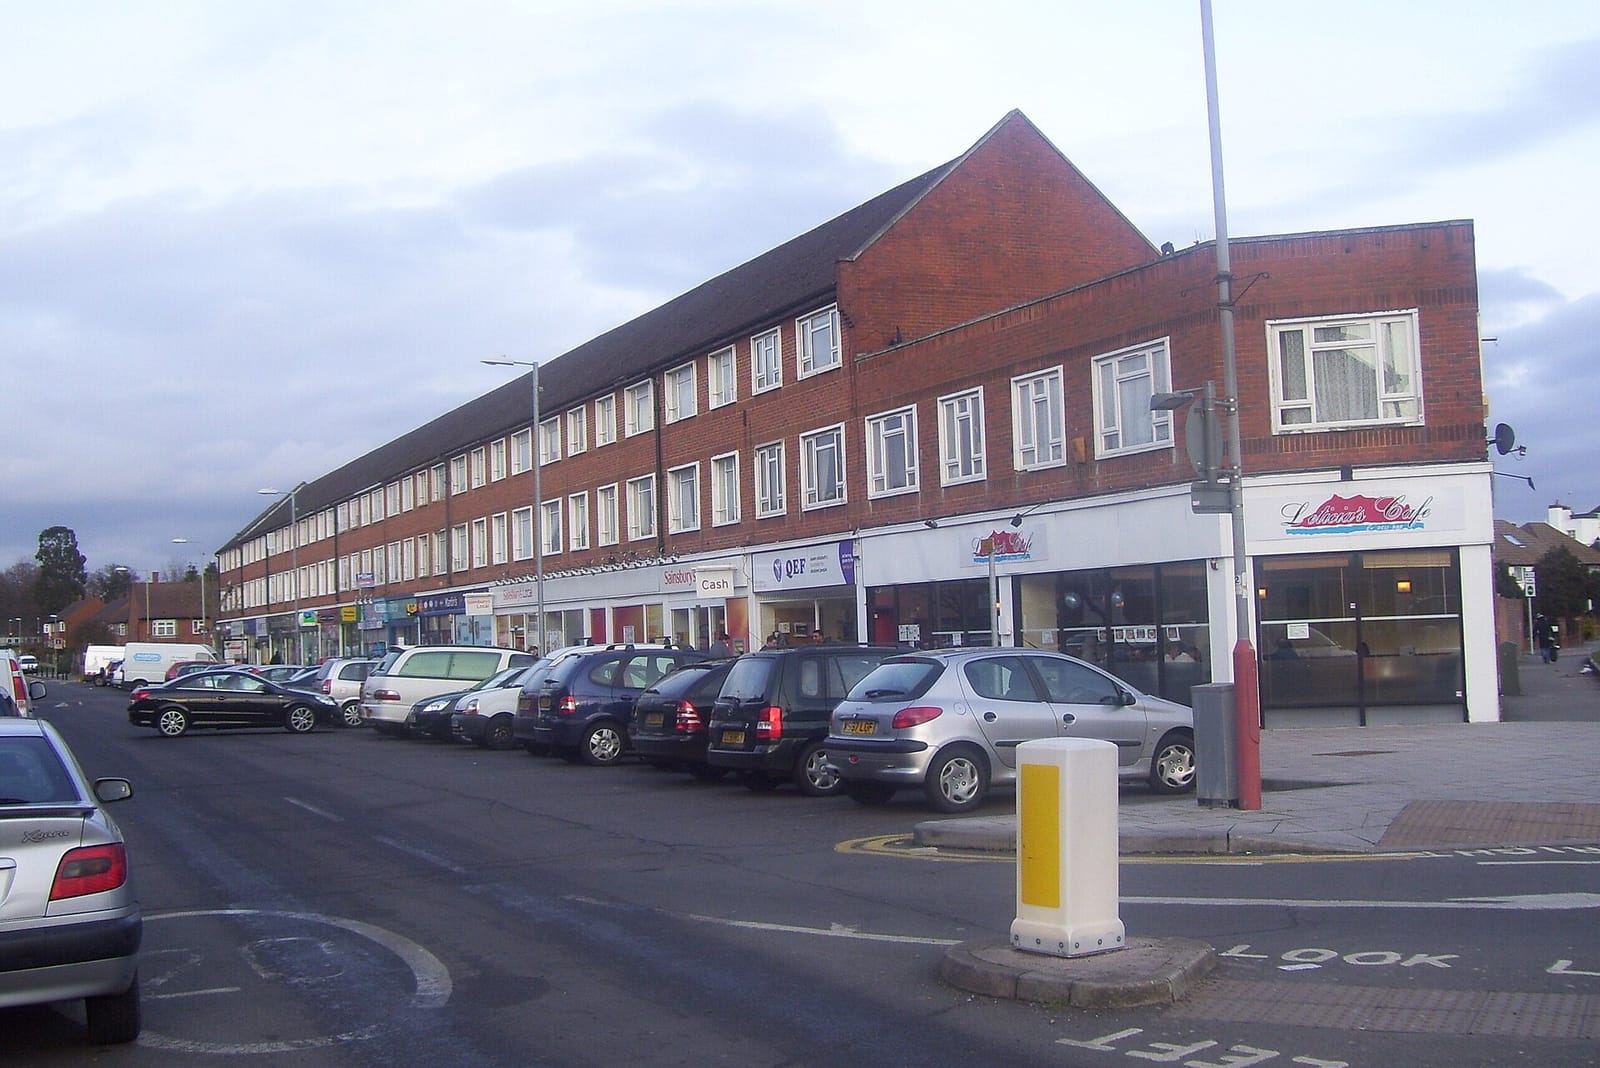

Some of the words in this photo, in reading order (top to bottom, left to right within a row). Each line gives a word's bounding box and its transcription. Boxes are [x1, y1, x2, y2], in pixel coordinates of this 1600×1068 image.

[1375, 495, 1433, 529] Cafe
[785, 558, 806, 578] QEF
[701, 579, 729, 590] Cash
[1218, 943, 1460, 969] LOOK
